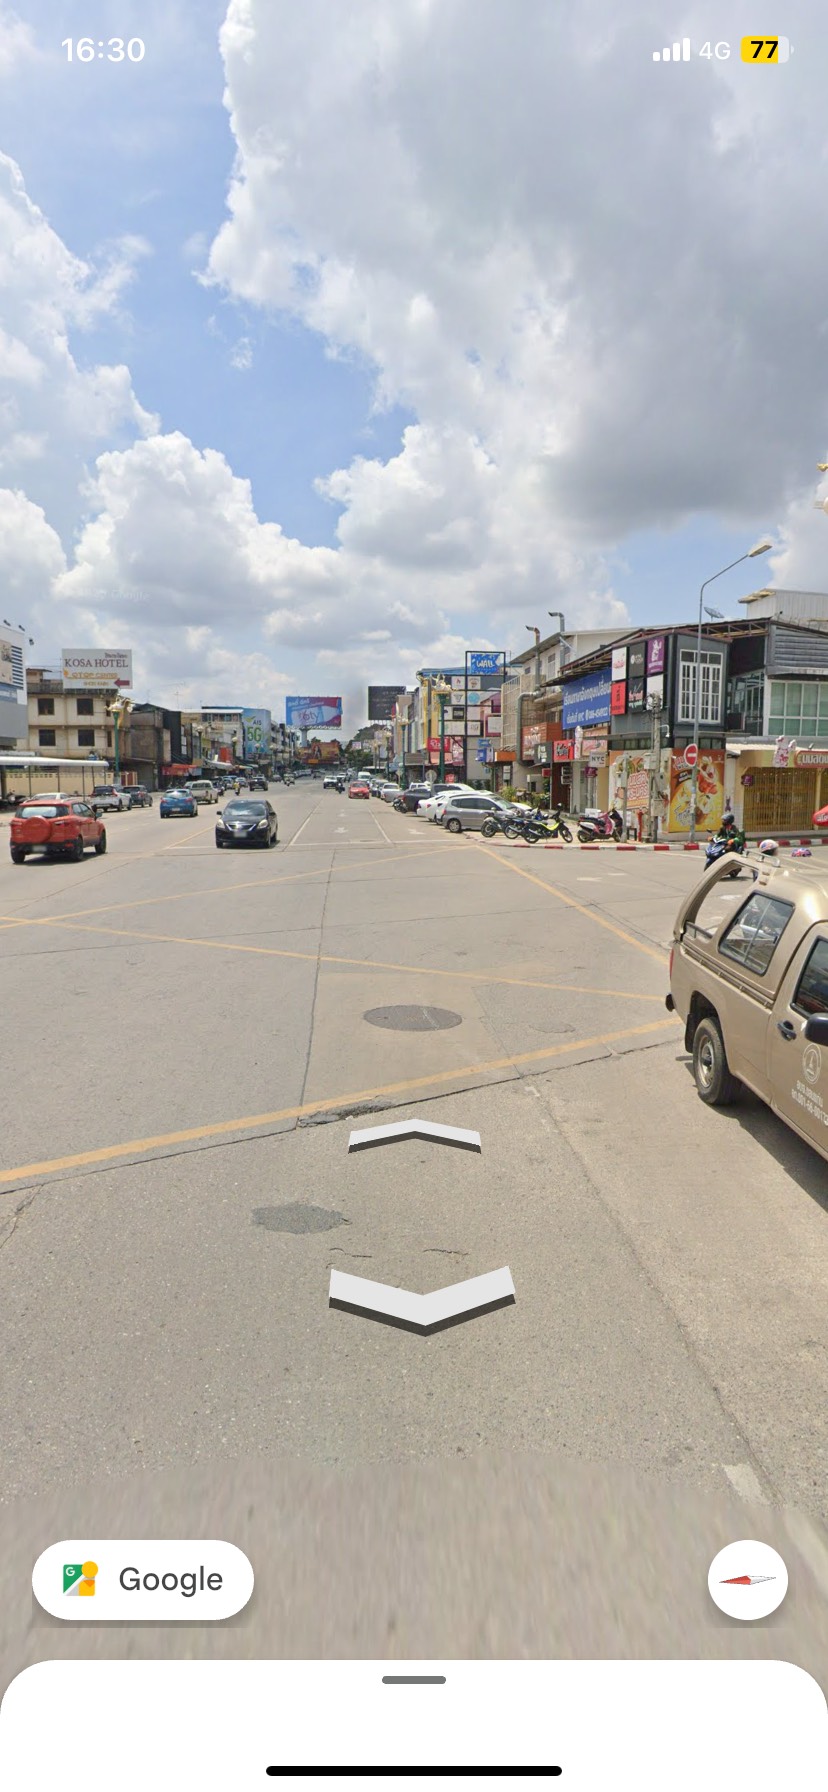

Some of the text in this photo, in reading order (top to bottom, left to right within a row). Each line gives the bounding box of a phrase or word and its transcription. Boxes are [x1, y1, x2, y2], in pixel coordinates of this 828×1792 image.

[64, 659, 129, 668] KOSA HOTEL
[246, 726, 262, 743] 5G
